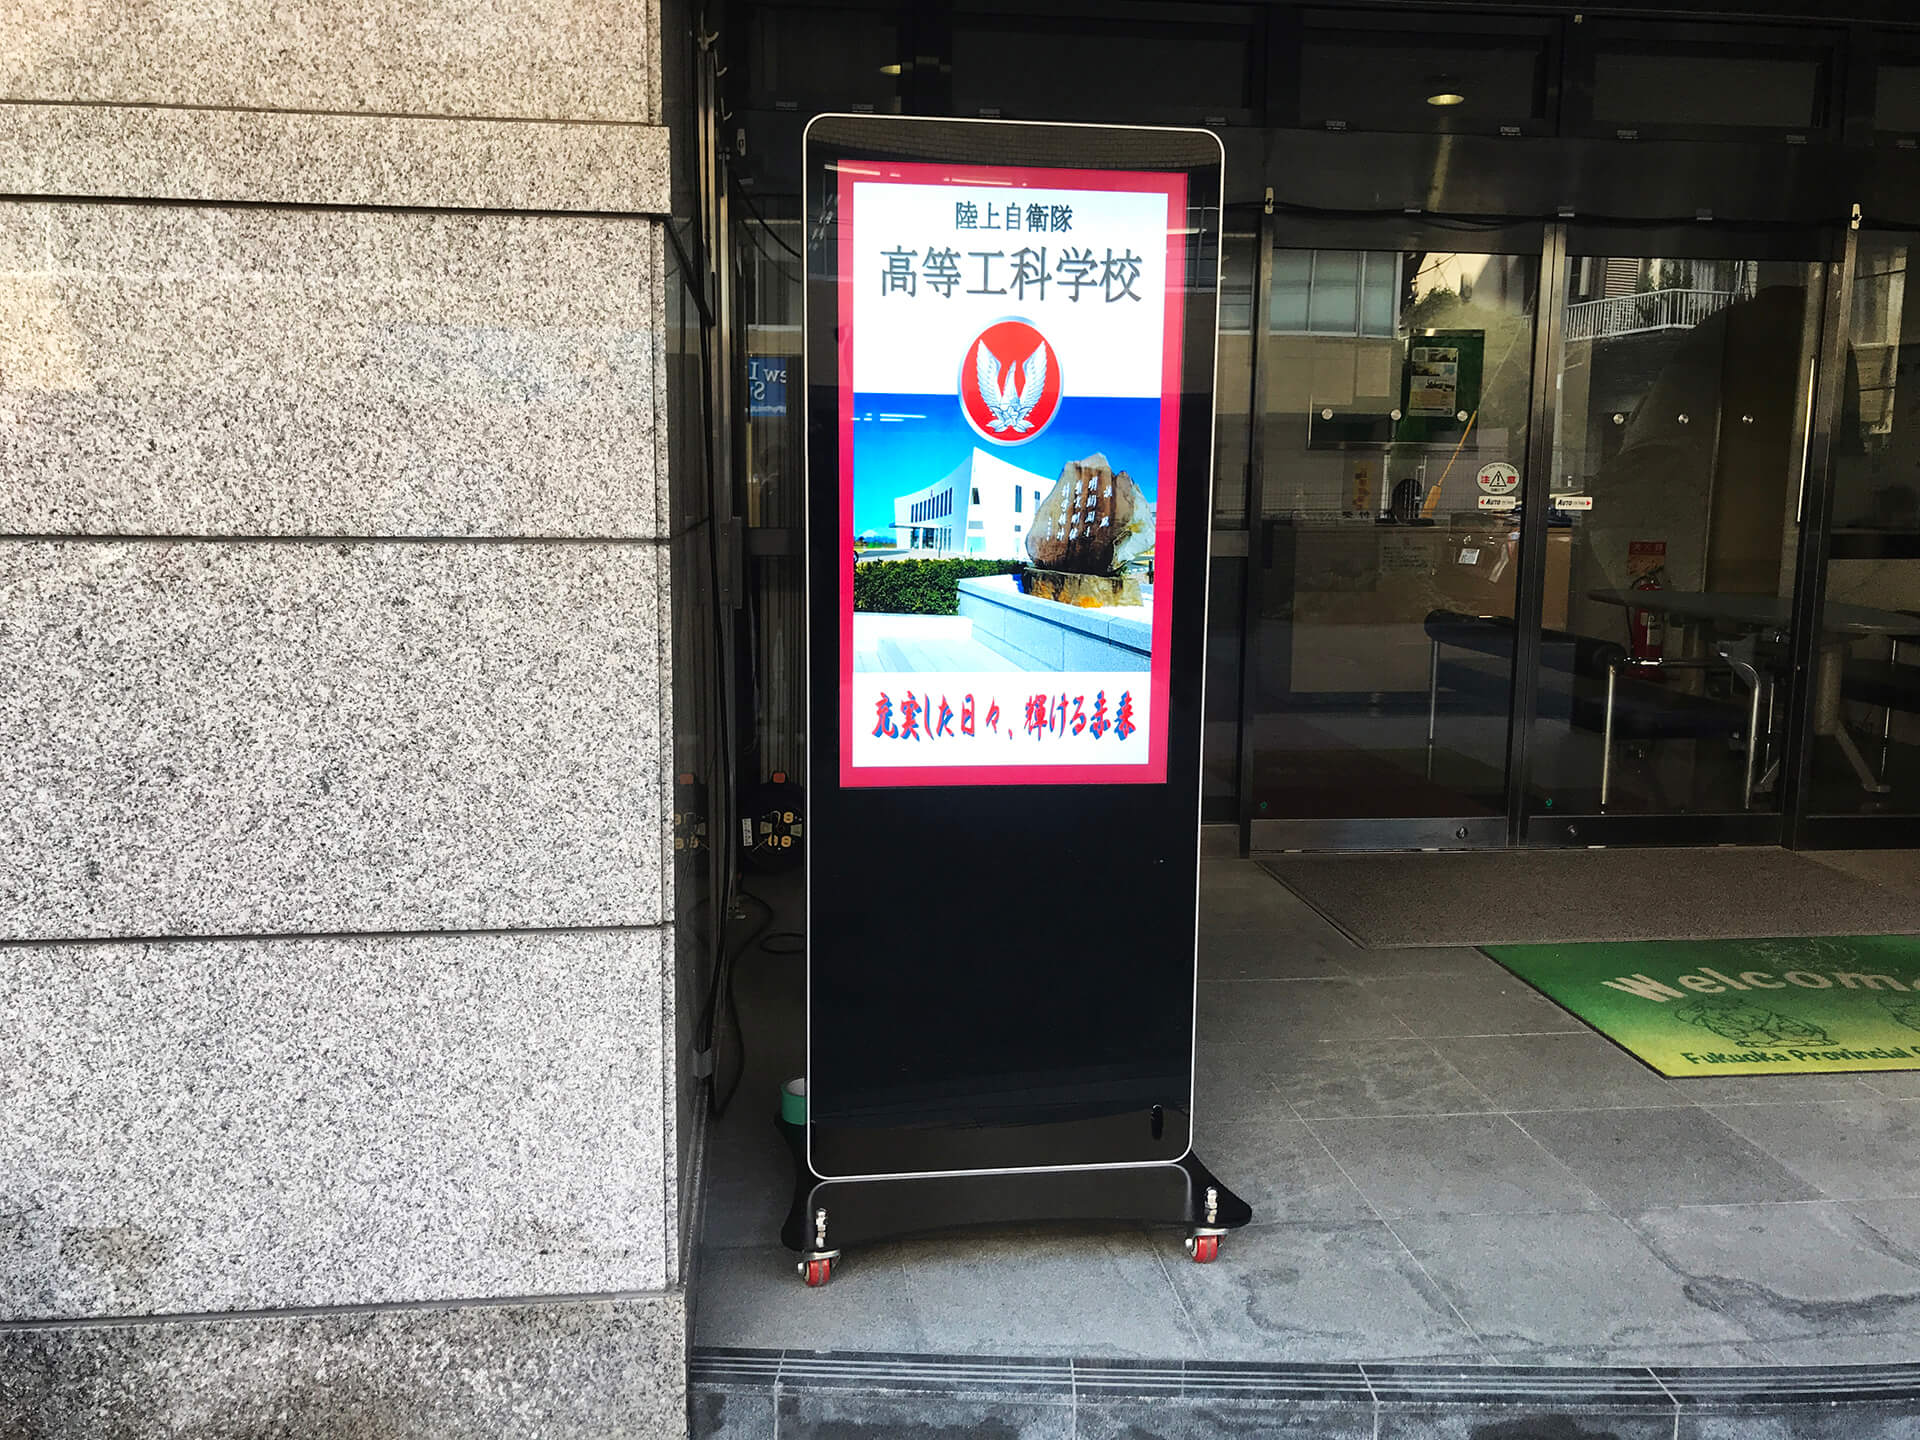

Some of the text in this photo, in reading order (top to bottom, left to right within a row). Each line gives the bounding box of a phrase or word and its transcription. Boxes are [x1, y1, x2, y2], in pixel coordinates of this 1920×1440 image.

[955, 200, 1073, 233] 陸上自衛隊
[880, 245, 1143, 303] 高等工科学校
[871, 690, 1137, 742] 充実した日々、輝ける未来
[1600, 966, 1920, 1003] Welcom
